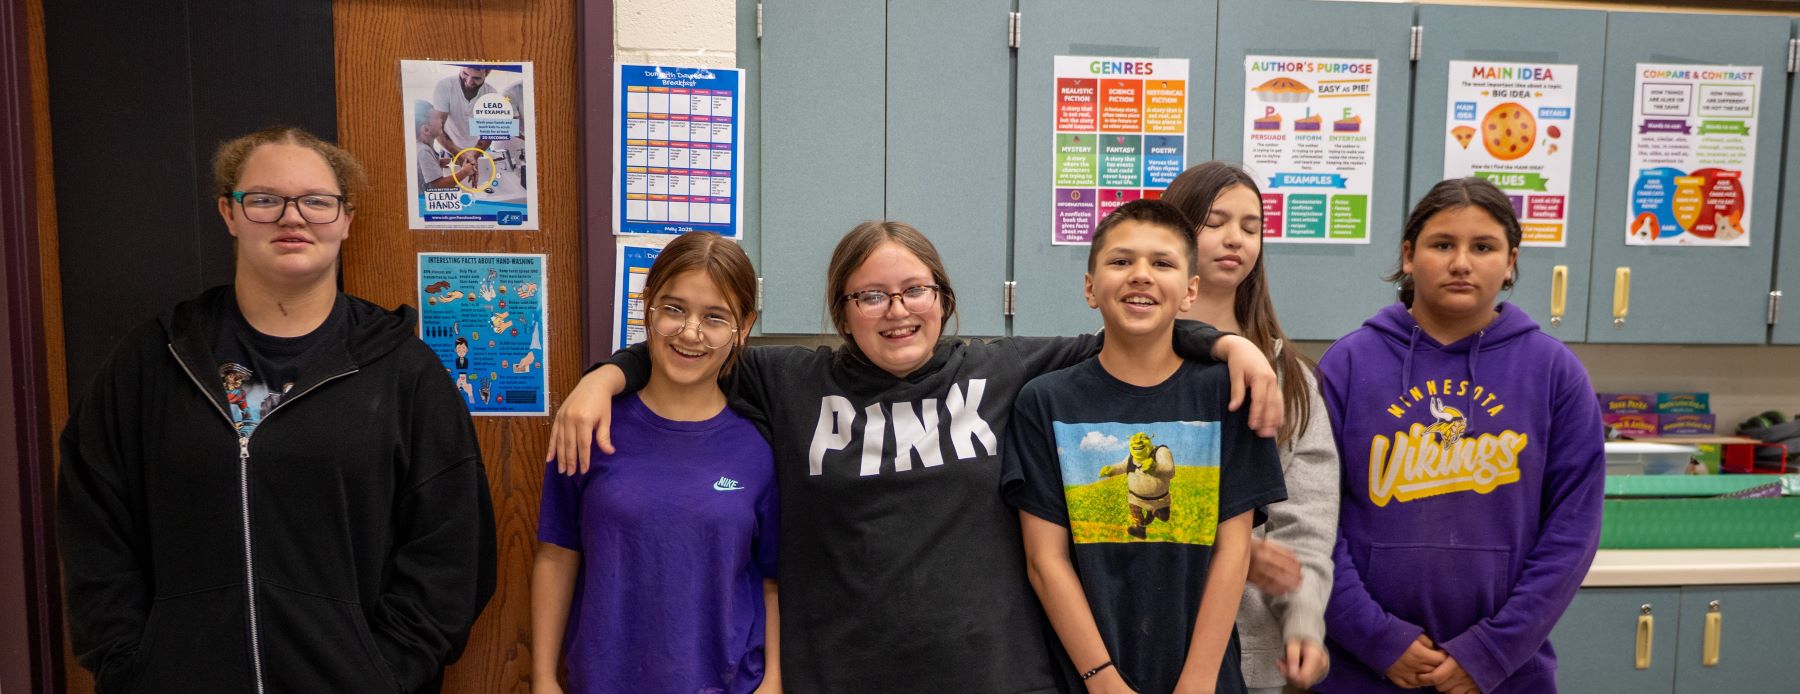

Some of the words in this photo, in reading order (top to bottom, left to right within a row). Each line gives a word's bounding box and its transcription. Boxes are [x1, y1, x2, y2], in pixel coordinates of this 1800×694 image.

[1090, 60, 1152, 75] GENRES
[1252, 62, 1313, 72] AUTHOR'S
[1317, 63, 1372, 74] PURPOSE
[1472, 66, 1512, 79] MAIN
[1517, 68, 1553, 80] IDEA
[1643, 70, 1690, 79] COMPARE
[1692, 71, 1699, 79] &
[1701, 72, 1753, 80] CONTRAST
[1265, 106, 1275, 118] P
[1343, 107, 1352, 120] E
[1283, 176, 1332, 184] EXAMPLES
[1488, 175, 1525, 186] CLUES
[428, 192, 458, 201] CLEAN
[429, 201, 461, 210] HANDS
[1387, 379, 1504, 418] MINNESOTA
[1628, 400, 1648, 410] Parks
[809, 378, 997, 476] PINK
[1368, 422, 1528, 507] Vikings
[718, 476, 738, 488] NIKE
